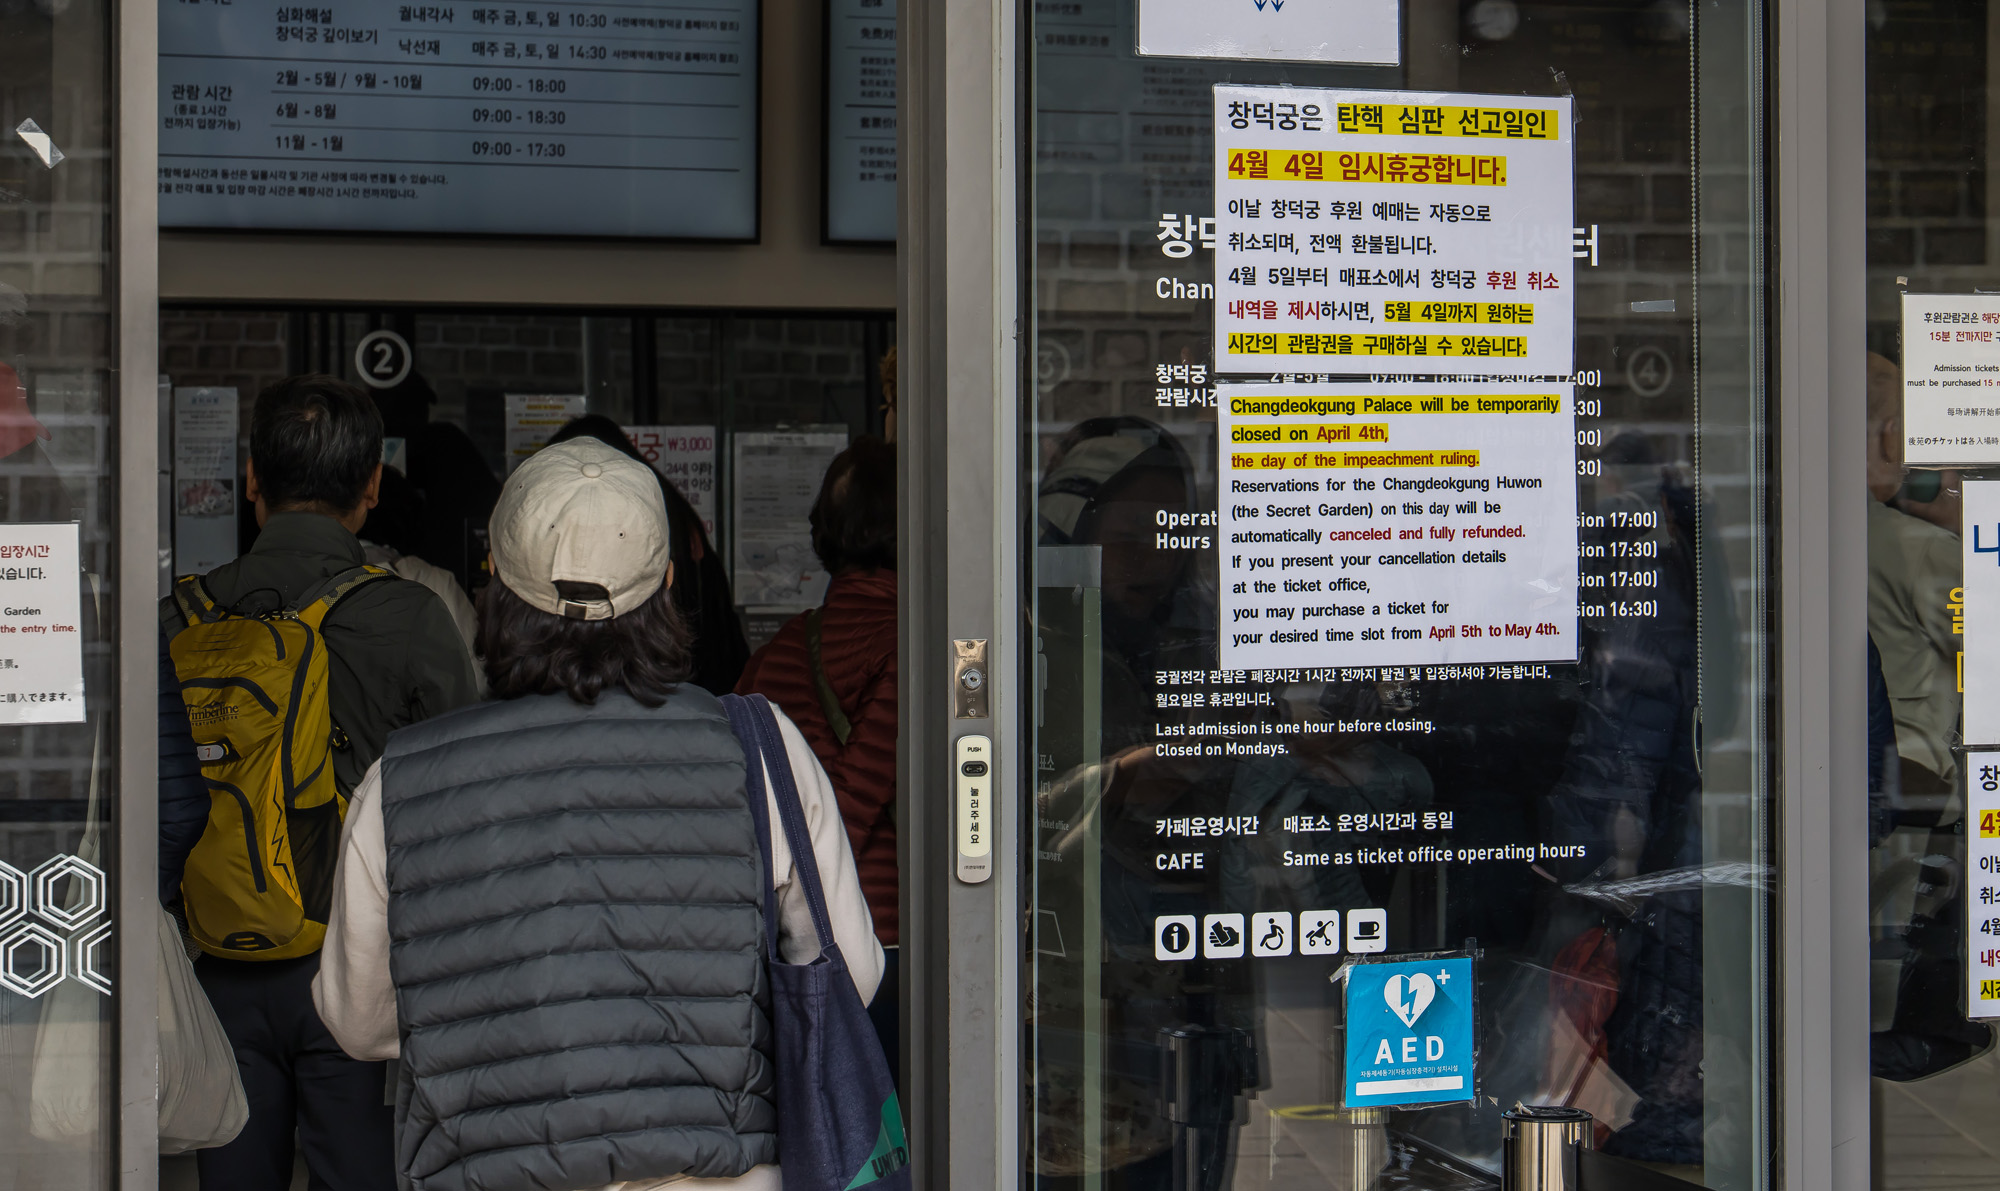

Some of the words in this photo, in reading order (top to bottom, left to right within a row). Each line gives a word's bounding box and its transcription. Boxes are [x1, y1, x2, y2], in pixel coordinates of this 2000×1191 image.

[1228, 102, 1323, 131] 창덕궁은
[1338, 105, 1383, 133] 탄핵
[1398, 107, 1444, 134] 심판
[1458, 109, 1546, 138] 선고일인
[1229, 151, 1268, 178] 4월
[1285, 152, 1323, 179] 4일
[1339, 153, 1505, 184] 임시휴궁합니다.
[1229, 199, 1261, 218] 이날
[1272, 200, 1320, 219] 창덕궁
[1330, 201, 1361, 220] 후원
[1373, 202, 1420, 221] 예매는
[1430, 203, 1491, 222] 자동으로
[1229, 232, 1299, 255] 취소되며,
[1310, 234, 1341, 253] 전액
[1352, 235, 1436, 255] 환불됩니다.
[1229, 266, 1256, 285] 4월
[1269, 267, 1327, 286] 5일부터
[1340, 268, 1419, 288] 매표소에서
[1431, 269, 1476, 289] 창덕궁
[1487, 271, 1516, 290] 후원
[1528, 272, 1559, 290] 취소
[1229, 300, 1278, 319] 내역을
[1288, 301, 1374, 323] 제시하시면,
[1385, 302, 1410, 321] 5월
[1421, 303, 1477, 322] 4일까지
[1487, 304, 1533, 323] 원하는
[1229, 334, 1276, 353] 시간의
[1288, 334, 1353, 354] 관람권을
[1363, 335, 1427, 355] 구매하실
[1437, 337, 1452, 355] 수
[1462, 337, 1526, 356] 있습니다.
[1929, 331, 1951, 343] 15분
[1955, 330, 1993, 343] 전까지만
[1156, 364, 1207, 384] 창덕궁
[1933, 364, 1972, 373] Admission
[1974, 364, 2000, 373] tickets
[1906, 379, 1926, 387] must
[1928, 378, 1939, 387] be
[1942, 378, 1982, 389] purchased
[1983, 378, 1993, 387] 15
[1231, 399, 1355, 416] Changdeokgung
[1363, 397, 1413, 412] Palace
[1419, 396, 1444, 412] will
[1451, 397, 1470, 412] be
[1477, 396, 1559, 414] temporarily
[1231, 426, 1281, 442] closed
[1289, 429, 1309, 441] on
[1317, 425, 1350, 443] April
[1359, 426, 1388, 443] 4th,
[1231, 454, 1254, 468] the
[1260, 454, 1287, 471] day
[1293, 453, 1308, 467] of
[1313, 453, 1337, 467] the
[1344, 453, 1434, 469] impeachment
[1440, 451, 1480, 468] ruling.
[1231, 478, 1320, 493] Reservations
[1325, 477, 1347, 492] for
[1352, 477, 1376, 491] the
[1383, 477, 1489, 493] Changdeokgung
[1496, 475, 1542, 489] Huwon
[1232, 505, 1258, 521] (the
[1266, 504, 1311, 518] Secret
[1318, 502, 1374, 519] Garden)
[1380, 505, 1397, 516] on
[1401, 501, 1424, 515] this
[1428, 501, 1450, 518] day
[1455, 500, 1477, 514] will
[1483, 500, 1501, 514] be
[1610, 511, 1656, 528] 17:00)
[1157, 533, 1210, 549] Hours
[1231, 528, 1323, 545] automatically
[1329, 527, 1392, 542] canceled
[1398, 526, 1423, 540] and
[1430, 526, 1455, 542] fully
[1462, 524, 1526, 539] refunded.
[1610, 540, 1657, 558] 17:30)
[1610, 570, 1657, 588] 17:00)
[3, 606, 41, 616] Garden
[1610, 600, 1657, 617] 16:30)
[0, 624, 17, 634] the
[21, 624, 48, 635] entry
[51, 623, 77, 633] time.
[1209, 668, 1247, 685] 관람은
[1250, 668, 1301, 684] 폐장시간
[1304, 668, 1337, 683] 1시간
[1340, 667, 1377, 682] 전까지
[1380, 667, 1405, 682] 발권
[1409, 666, 1421, 681] 및
[1425, 665, 1485, 681] 입장하셔야
[1488, 664, 1551, 680] 가능합니다.
[1155, 692, 1206, 708] 월요일은
[1209, 691, 1275, 707] 휴관입니다.
[1155, 722, 1185, 737] Last
[1188, 721, 1258, 736] admission
[1260, 720, 1273, 735] is
[1275, 723, 1301, 734] one
[1303, 720, 1335, 734] hour
[1338, 719, 1382, 733] before
[1385, 717, 1436, 734] closing.
[1155, 742, 1202, 757] Closed
[1205, 745, 1222, 756] on
[1225, 741, 1289, 758] Mondays.
[1156, 816, 1259, 837] 카페운영시간
[1284, 815, 1331, 833] 매표소
[1337, 812, 1416, 831] 운영시간과
[1422, 811, 1452, 829] 동일
[1156, 853, 1203, 870] CAFE
[1282, 850, 1330, 867] Same
[1334, 852, 1353, 865] as
[1356, 847, 1404, 864] ticket
[1409, 846, 1452, 862] office
[1458, 844, 1534, 864] operating
[1539, 842, 1586, 859] hours
[1375, 1036, 1444, 1064] AED
